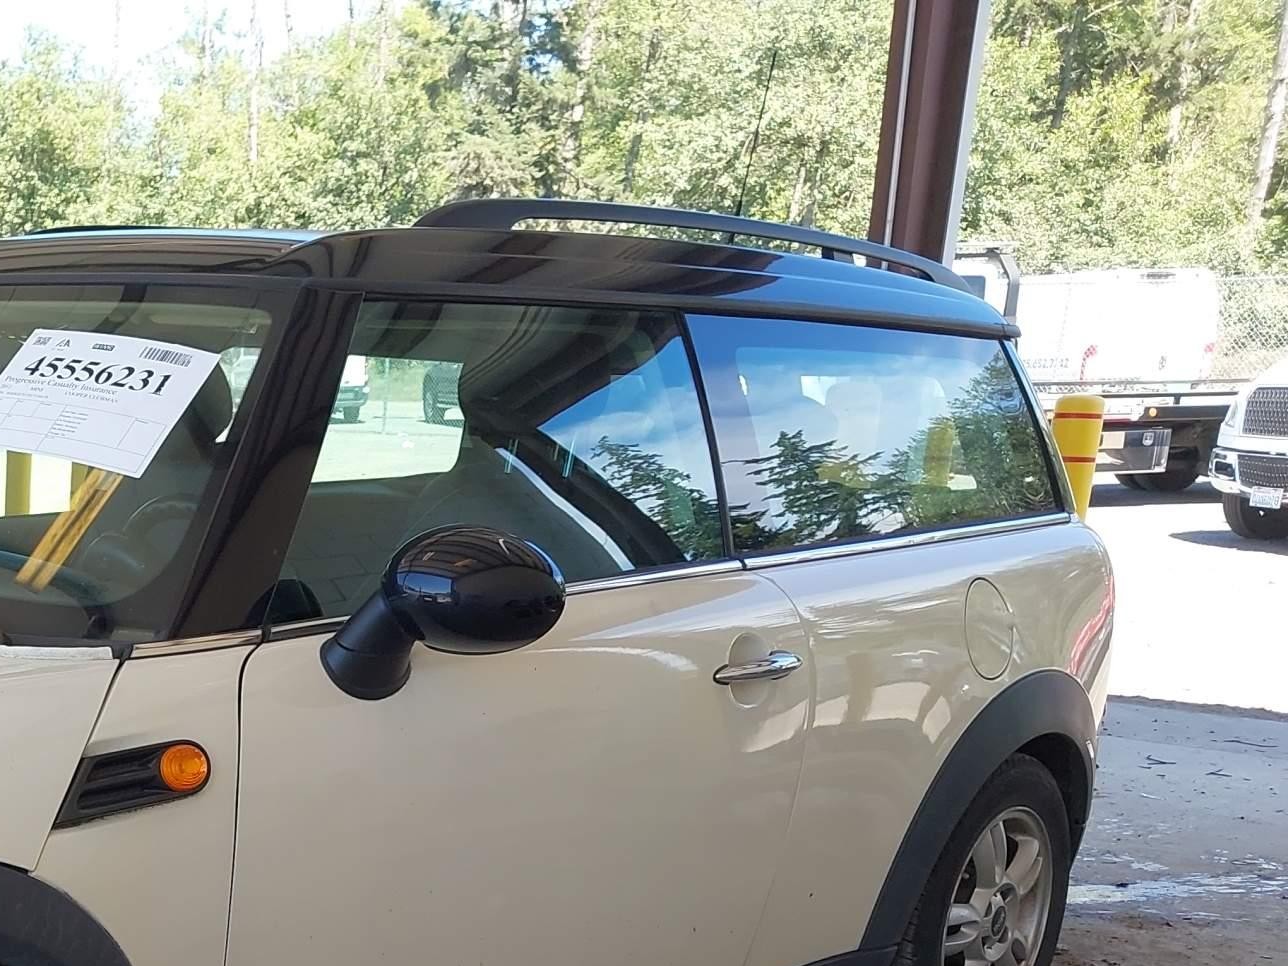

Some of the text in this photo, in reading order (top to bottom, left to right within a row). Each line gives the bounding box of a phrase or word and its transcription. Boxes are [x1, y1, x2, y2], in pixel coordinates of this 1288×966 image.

[4, 375, 118, 395] Progressive Casualty Insurance
[24, 355, 173, 396] 45556231
